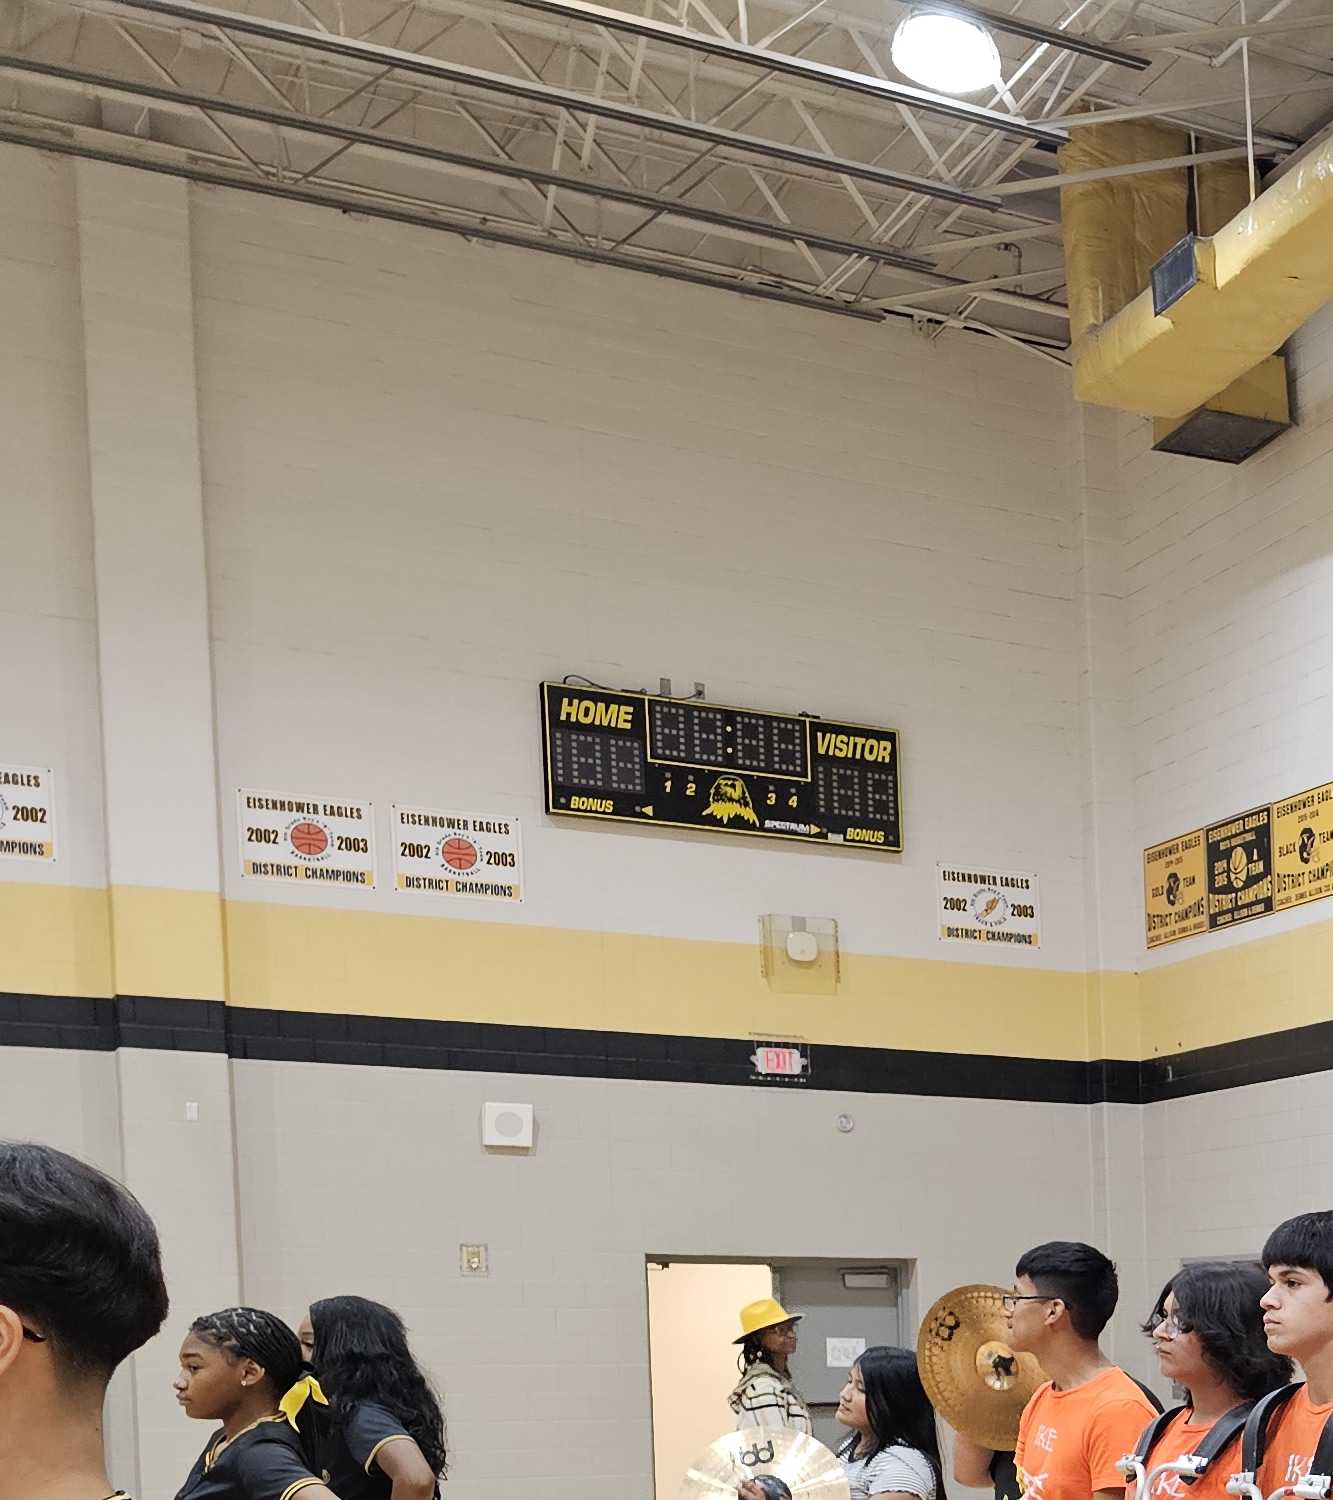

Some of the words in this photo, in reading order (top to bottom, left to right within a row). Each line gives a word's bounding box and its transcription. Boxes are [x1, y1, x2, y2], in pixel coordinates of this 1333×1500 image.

[559, 697, 634, 730] HOME
[816, 731, 893, 763] VISITOR
[664, 780, 673, 793] 1
[685, 783, 697, 796] 2
[766, 793, 777, 805] 3
[788, 795, 798, 808] 4
[246, 796, 319, 815] EISENHOWER
[323, 804, 363, 820] EAGLES
[570, 796, 614, 813] BONUS
[1276, 794, 1315, 819] EISENHOWER
[11, 805, 47, 824] 2002
[400, 812, 469, 831] EISENHOWER
[472, 820, 510, 835] EAGLES
[246, 827, 279, 845] 2002
[336, 835, 369, 853] 2003
[845, 827, 885, 843] BONUS
[1180, 835, 1201, 852] EAGLES
[400, 841, 431, 859] 2002
[485, 850, 516, 868] 2003
[1278, 841, 1297, 858] BLACK
[252, 862, 299, 878] DISTRICT
[304, 866, 366, 884] CHAMPIONS
[1248, 860, 1264, 876] TEAM
[405, 875, 449, 891] DISTRICT
[455, 880, 513, 897] CHAMPIONS
[942, 870, 998, 886] EISENHOWER
[1000, 876, 1030, 890] EAGLES
[1182, 875, 1196, 889] TEAM
[1276, 872, 1306, 894] DISTRICT
[943, 896, 967, 912] 2002
[1010, 903, 1035, 918] 2003
[947, 926, 982, 940] DISTRICT
[986, 930, 1033, 945] CHAMPIONS
[765, 1050, 794, 1072] EXIT
